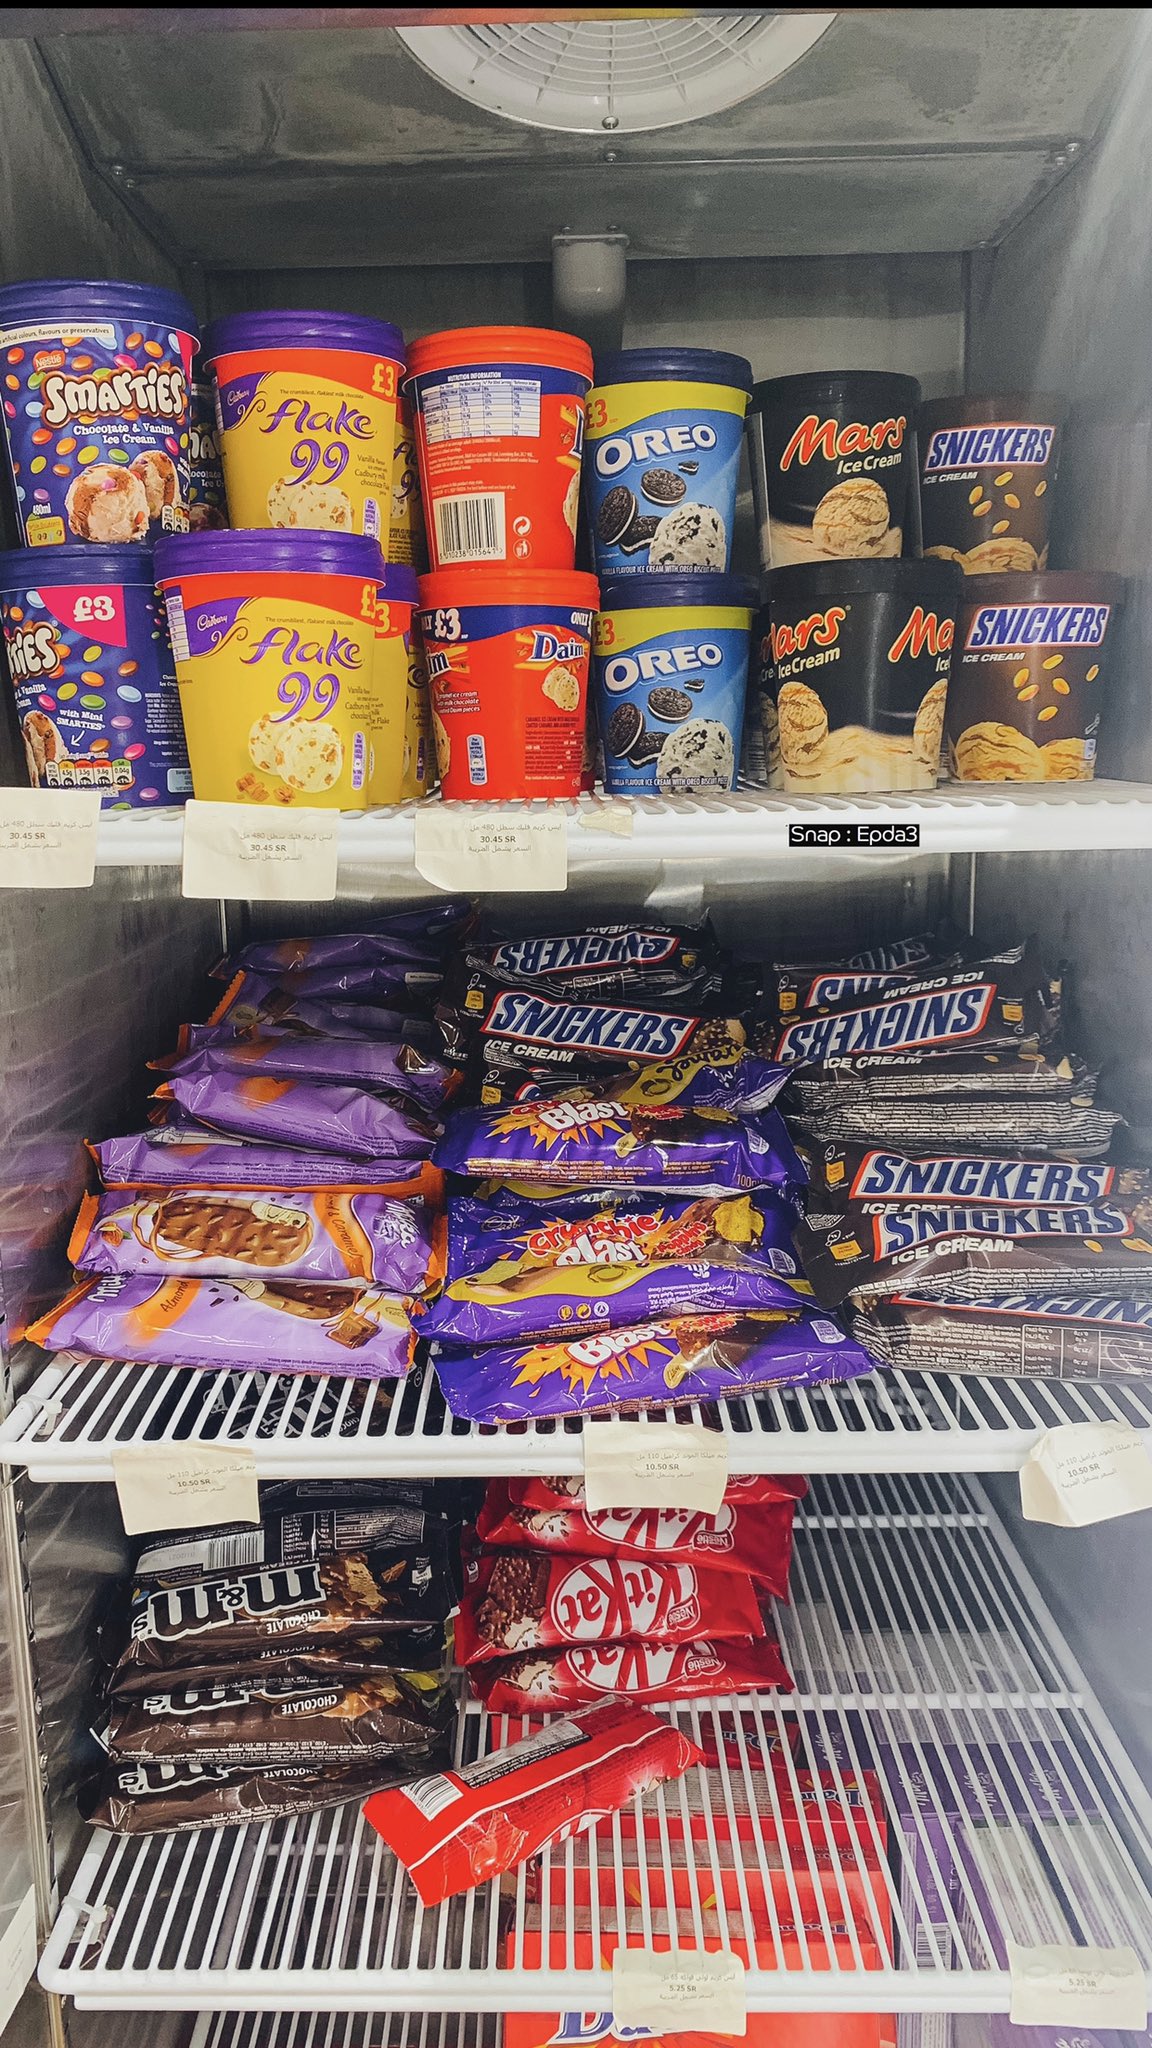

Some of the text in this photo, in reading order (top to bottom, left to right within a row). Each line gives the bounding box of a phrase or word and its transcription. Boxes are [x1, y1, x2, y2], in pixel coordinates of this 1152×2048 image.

[70, 328, 109, 336] preservatives
[372, 363, 394, 396] £3
[448, 372, 501, 381] NUTRITION INFORMATION
[227, 389, 249, 406] Cadbury
[74, 423, 174, 435] Chocolate & Vanilla
[259, 399, 377, 440] flake
[103, 434, 156, 444] Ice Cream
[596, 426, 716, 475] OREO
[780, 415, 906, 471] Mars
[928, 429, 1052, 468] SNICKERS
[284, 439, 349, 486] 99
[358, 455, 375, 464] Vanilla
[837, 453, 902, 475] Ice Cream
[355, 469, 377, 478] Cadbury
[923, 471, 978, 485] ICE CREAM
[616, 566, 636, 574] FLAVOUR
[73, 596, 115, 622] £3
[571, 612, 588, 625] ONLY
[197, 614, 227, 631] Cadbury
[435, 608, 461, 640] £3
[593, 618, 615, 645] £3
[971, 608, 1107, 646] SNICKERS
[240, 627, 363, 670] flake
[526, 630, 584, 663] Daim
[962, 653, 1025, 663] ICE CREAM
[605, 644, 722, 691] OREO
[779, 648, 840, 679] Ice Cream
[270, 672, 340, 723] 99
[348, 686, 363, 694] Vanilla
[56, 717, 103, 730] SMARTIES
[60, 709, 102, 721] with Mini
[586, 925, 672, 935] ICE CREAM
[498, 934, 671, 973] SNICKERS
[884, 976, 948, 999] CREAM
[952, 971, 984, 982] ICE
[490, 996, 686, 1056] SNICKERS
[786, 988, 984, 1060] SNICKERS
[485, 1040, 574, 1063] ICE CREAM
[823, 1054, 923, 1069] ICE CREAM
[539, 1101, 628, 1130] Blast
[862, 1154, 1103, 1203] SNICKERS
[862, 1204, 891, 1214] ICE
[386, 1200, 421, 1248] Milka
[528, 1215, 660, 1257] crunchie
[885, 1203, 1125, 1253] SNICKERS
[336, 1219, 363, 1259] Caramel
[657, 1221, 708, 1254] popping
[892, 1239, 1014, 1265] ICE CREAM
[160, 1280, 190, 1312] Almond
[564, 1326, 670, 1366] Blast
[1068, 1463, 1100, 1477] 10.50 SR
[561, 1560, 682, 1637] KitKat
[266, 1609, 321, 1634] CHOCOLATE
[281, 1694, 338, 1715] CHOCOLATE
[1069, 1978, 1084, 1986] 5.25
